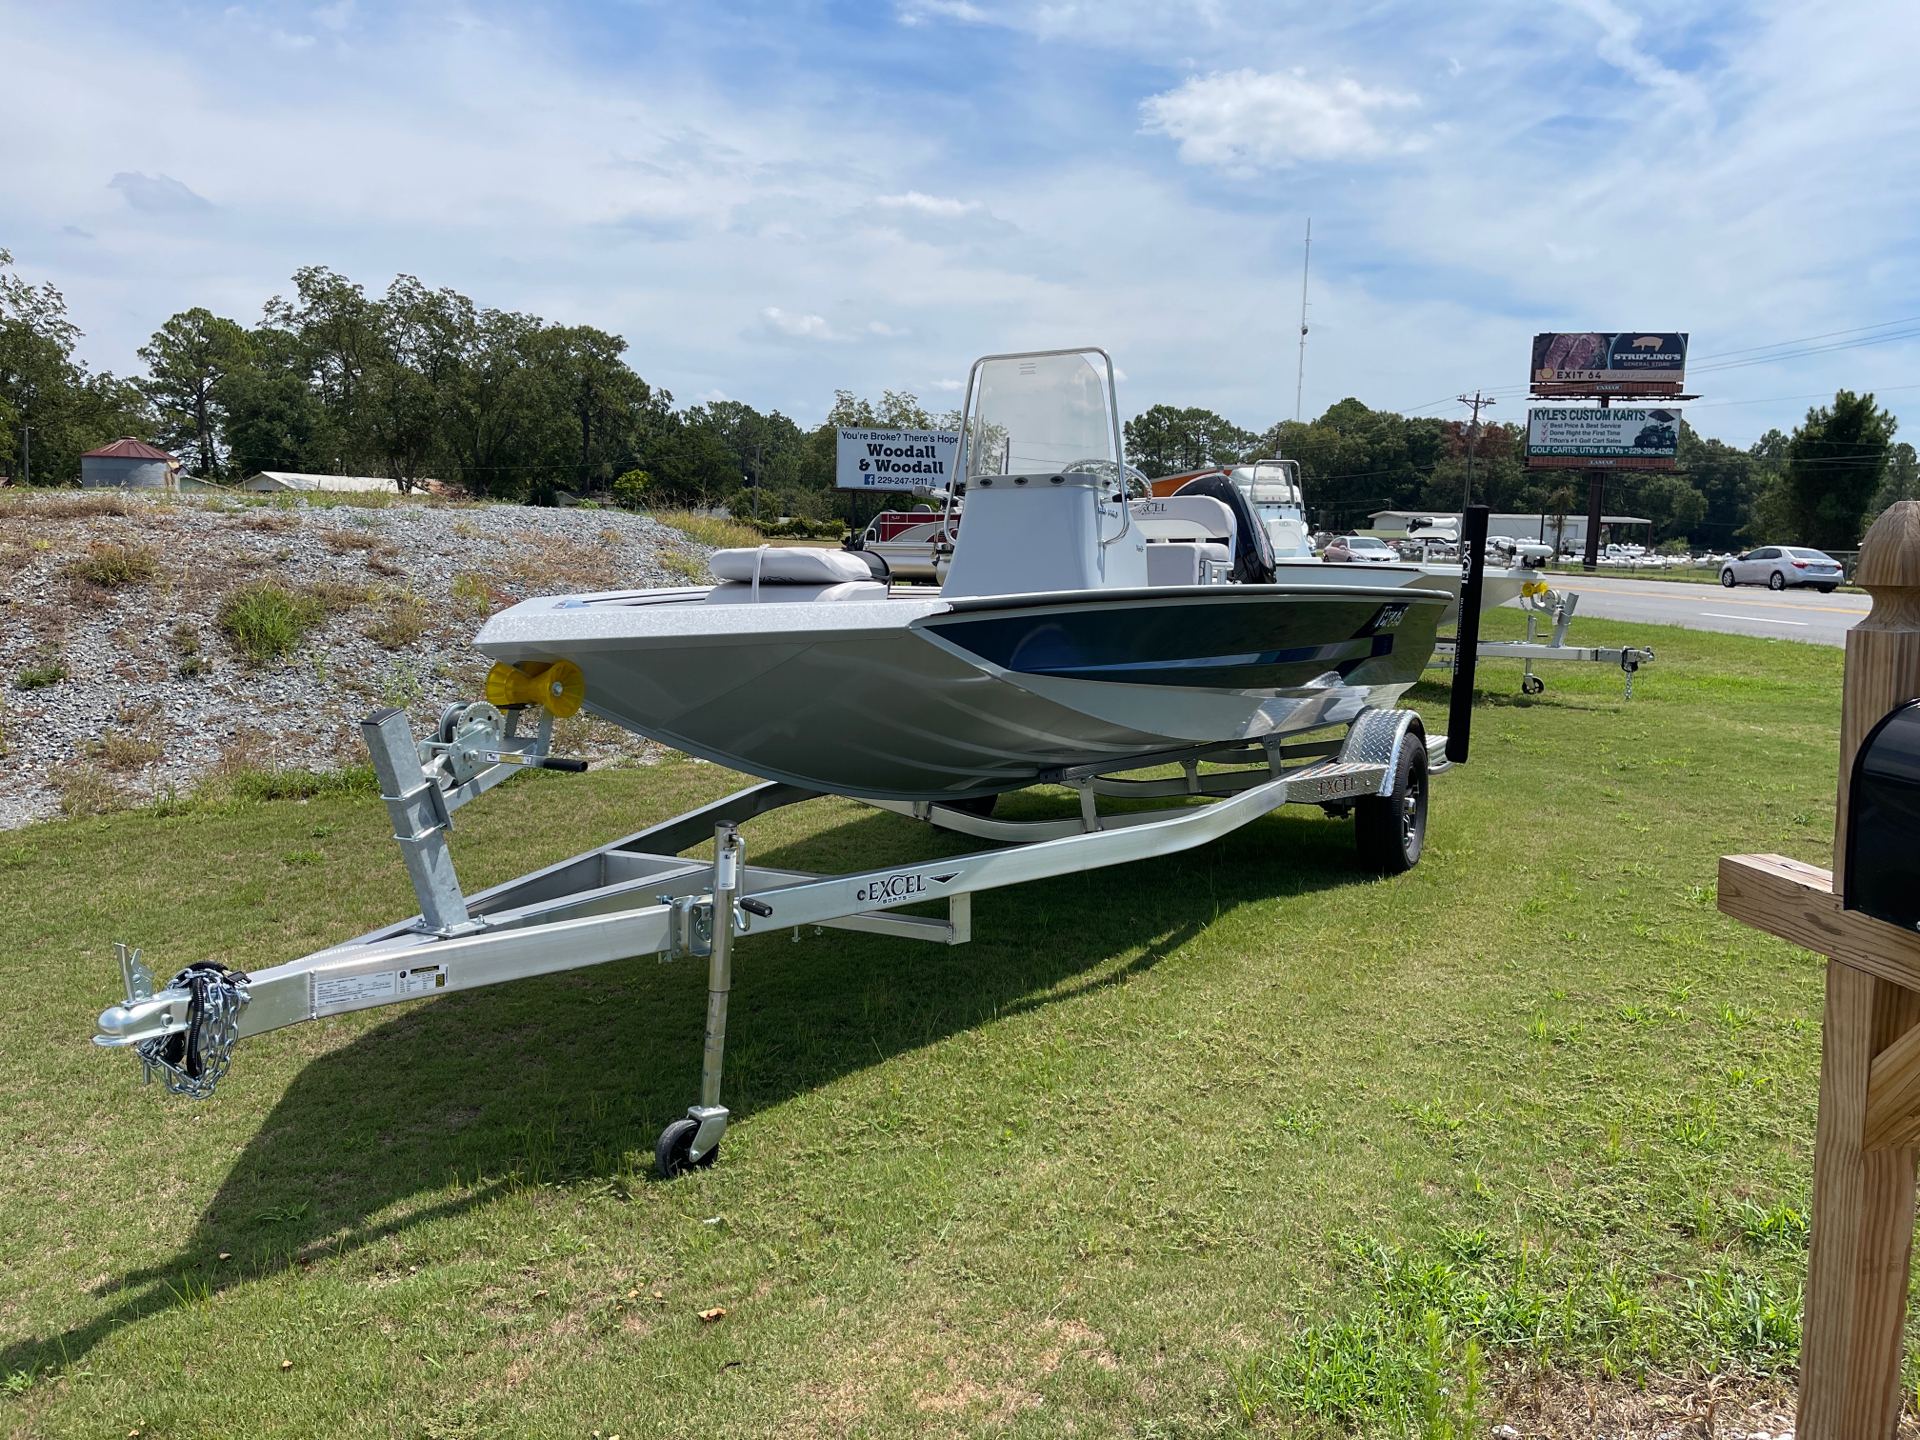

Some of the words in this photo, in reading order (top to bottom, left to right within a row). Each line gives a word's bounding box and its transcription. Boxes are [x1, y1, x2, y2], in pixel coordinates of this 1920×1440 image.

[1556, 371, 1584, 379] EXIT
[1588, 371, 1602, 379] 64
[1534, 409, 1567, 420] KYLE'S
[1569, 409, 1611, 421] CUSTOM
[1613, 410, 1646, 421] KARTS
[841, 431, 868, 440] You're
[870, 432, 902, 441] Broke?
[903, 433, 935, 443] There's
[937, 434, 959, 445] Hope
[866, 443, 936, 458] Woodall
[1531, 446, 1551, 454] GOLF
[1552, 447, 1578, 455] CARTS,
[858, 458, 871, 472] &
[874, 459, 944, 474] Woodall
[877, 476, 928, 485] 229-247-1211
[1319, 775, 1357, 795] EXCEL
[868, 872, 927, 902] EXCEL
